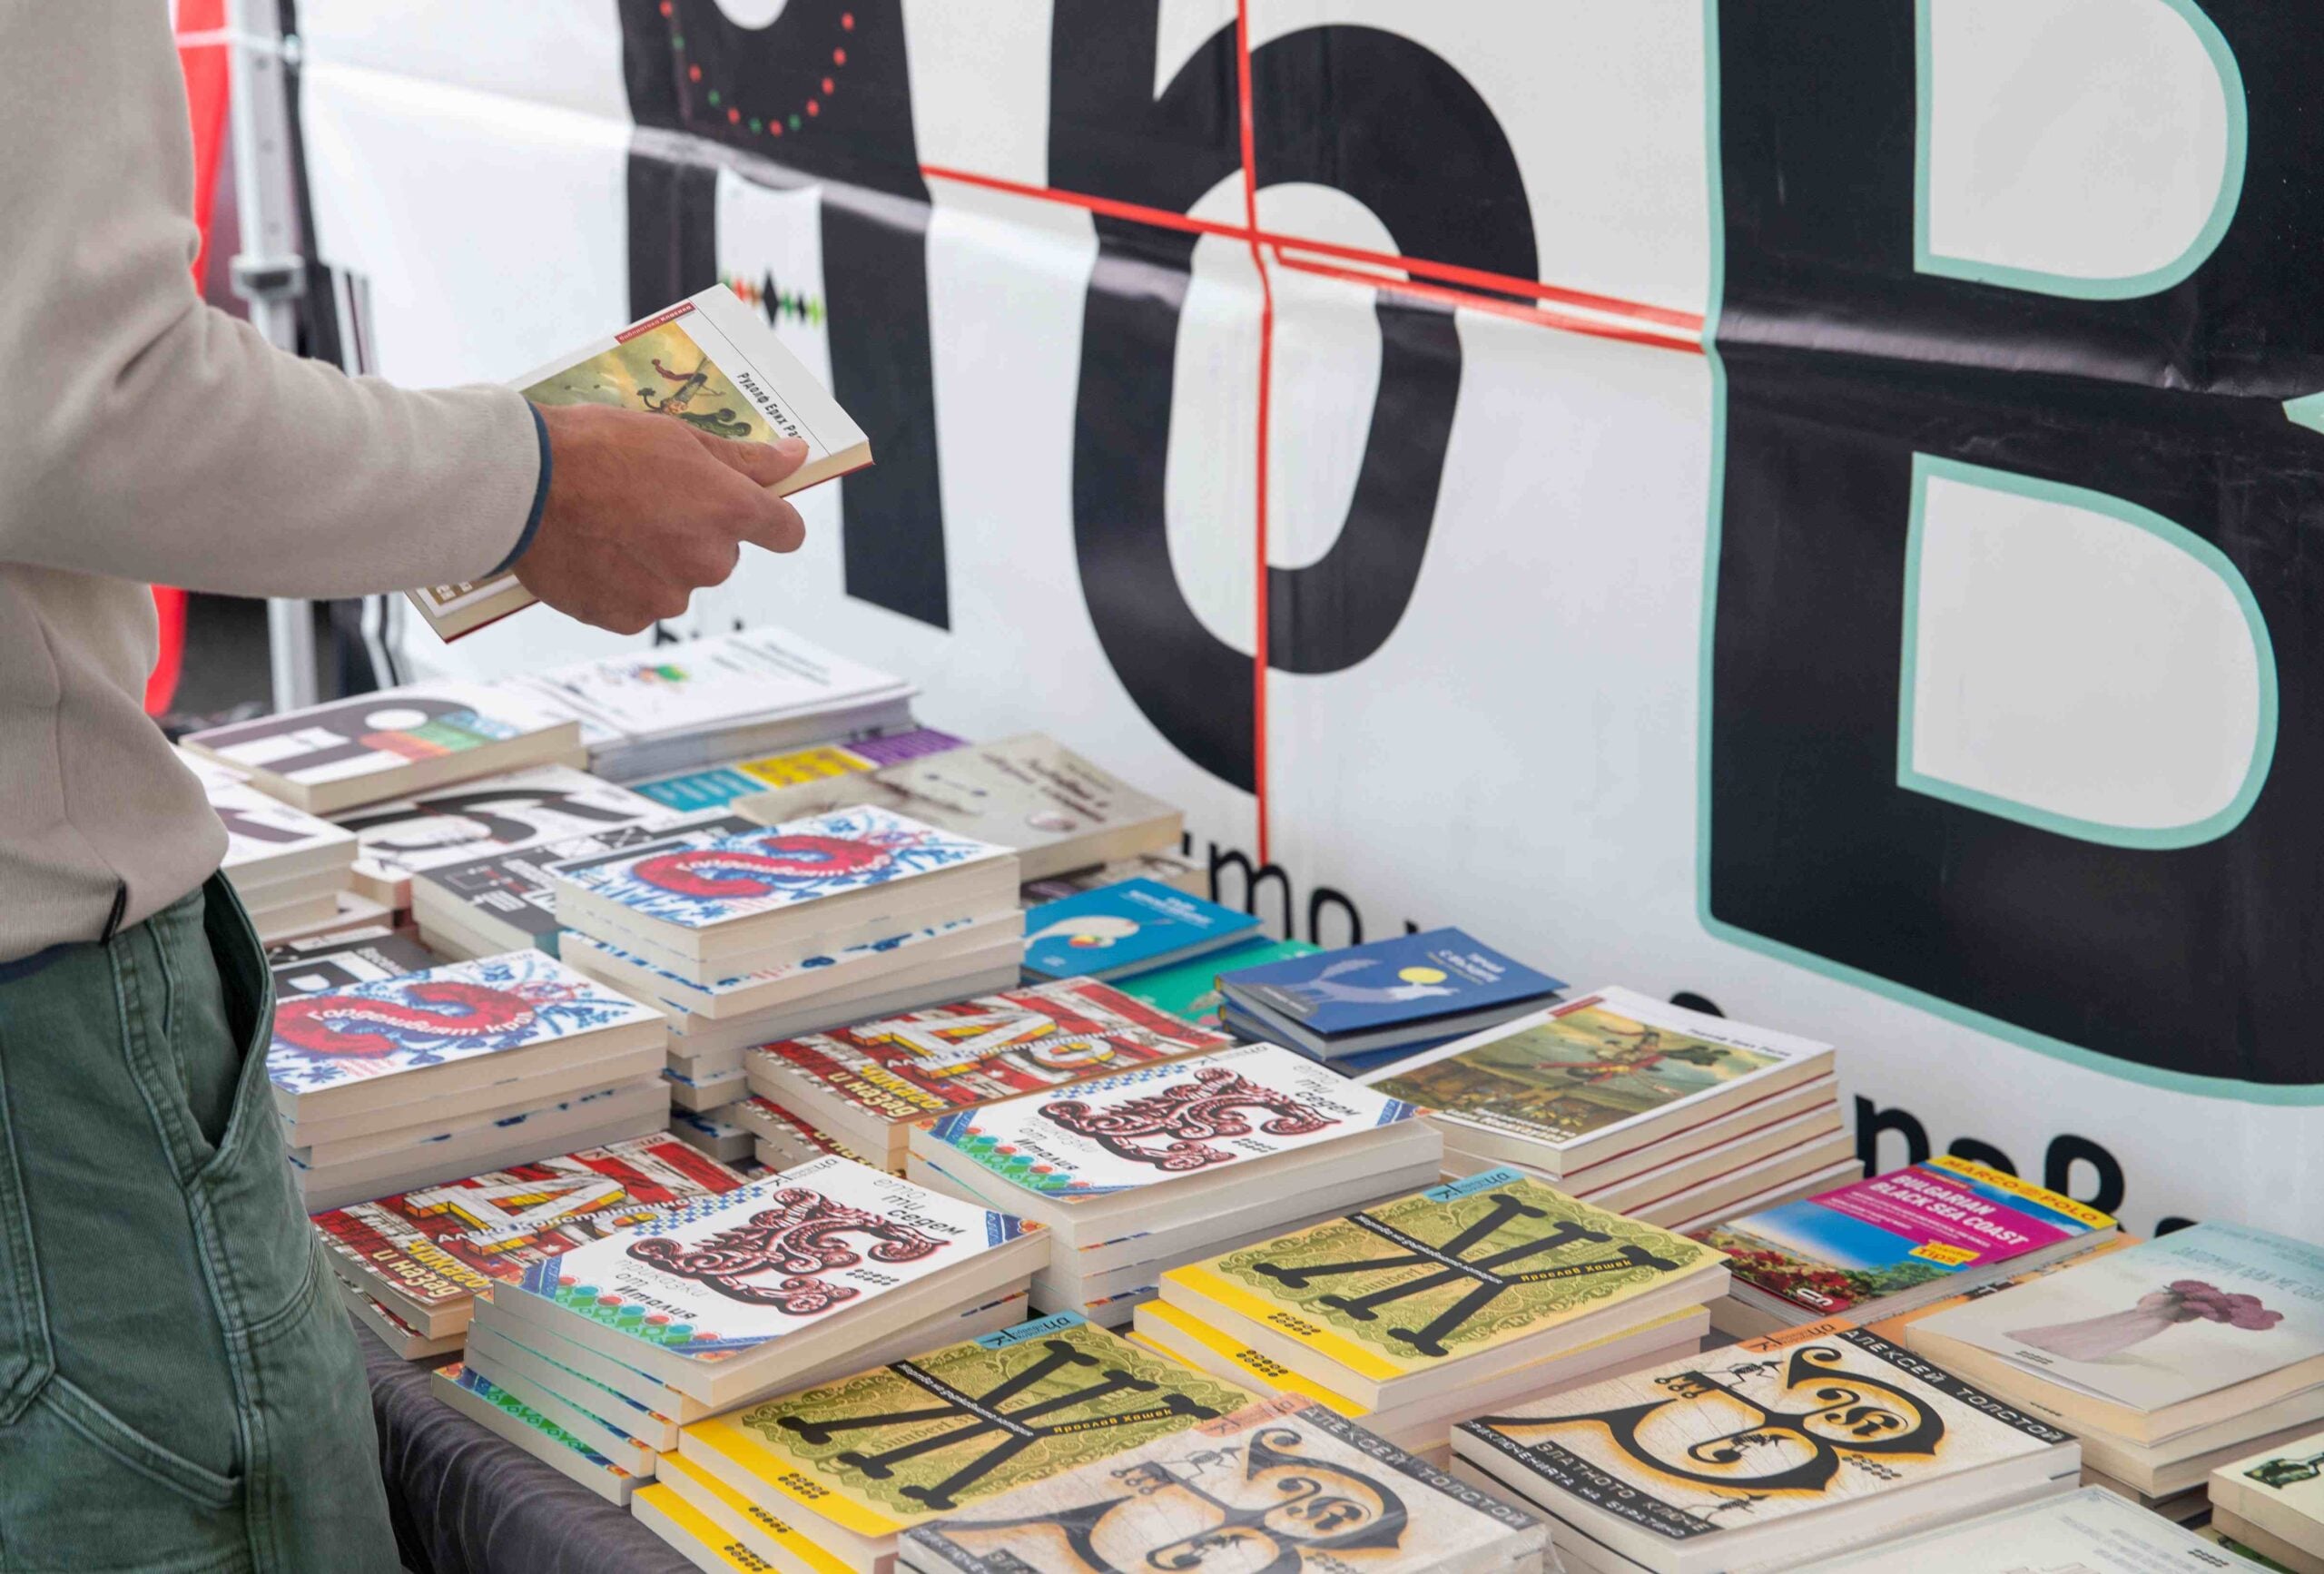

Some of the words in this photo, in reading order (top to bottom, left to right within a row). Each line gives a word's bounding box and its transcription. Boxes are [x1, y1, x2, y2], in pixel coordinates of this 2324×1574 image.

[737, 372, 769, 404] Рудолф
[764, 403, 784, 426] Ерих
[1295, 1091, 1362, 1117] седем
[1012, 1138, 1079, 1171] Италия
[881, 1194, 926, 1211] ти
[1892, 1174, 1996, 1215] BULGARIAN
[1943, 1159, 2020, 1188] MARCO
[2040, 1192, 2099, 1223] POLO
[887, 1208, 967, 1236] седем
[1868, 1181, 1934, 1207] BLACK
[1926, 1202, 1966, 1221] SEA
[1962, 1216, 2030, 1247] COAST
[393, 1258, 463, 1300] назад
[408, 1240, 490, 1290] Чикаго
[614, 1273, 651, 1288] от
[1521, 1265, 1581, 1282] Ярослав
[1588, 1258, 1633, 1274] Хашек
[614, 1284, 698, 1320] Италия
[1845, 1330, 1946, 1384] АЛЕКСЕЙ
[1955, 1387, 2065, 1442] ТОЛСТОЙ
[1052, 1417, 1118, 1435] Ярослав
[1121, 1408, 1174, 1425] Хашек
[1306, 1407, 1409, 1464] АЛЕКСЕЙ
[1417, 1468, 1531, 1530] ТОЛСТОЙ
[1465, 1420, 1574, 1487] ПРИКЛЮЧЕНИЯТА
[1578, 1487, 1600, 1500] НА
[1605, 1500, 1686, 1538] БУРАТИНО
[1536, 1443, 1636, 1500] ЗЛАТНОТО
[1642, 1500, 1710, 1532] КЛЮЧЕ
